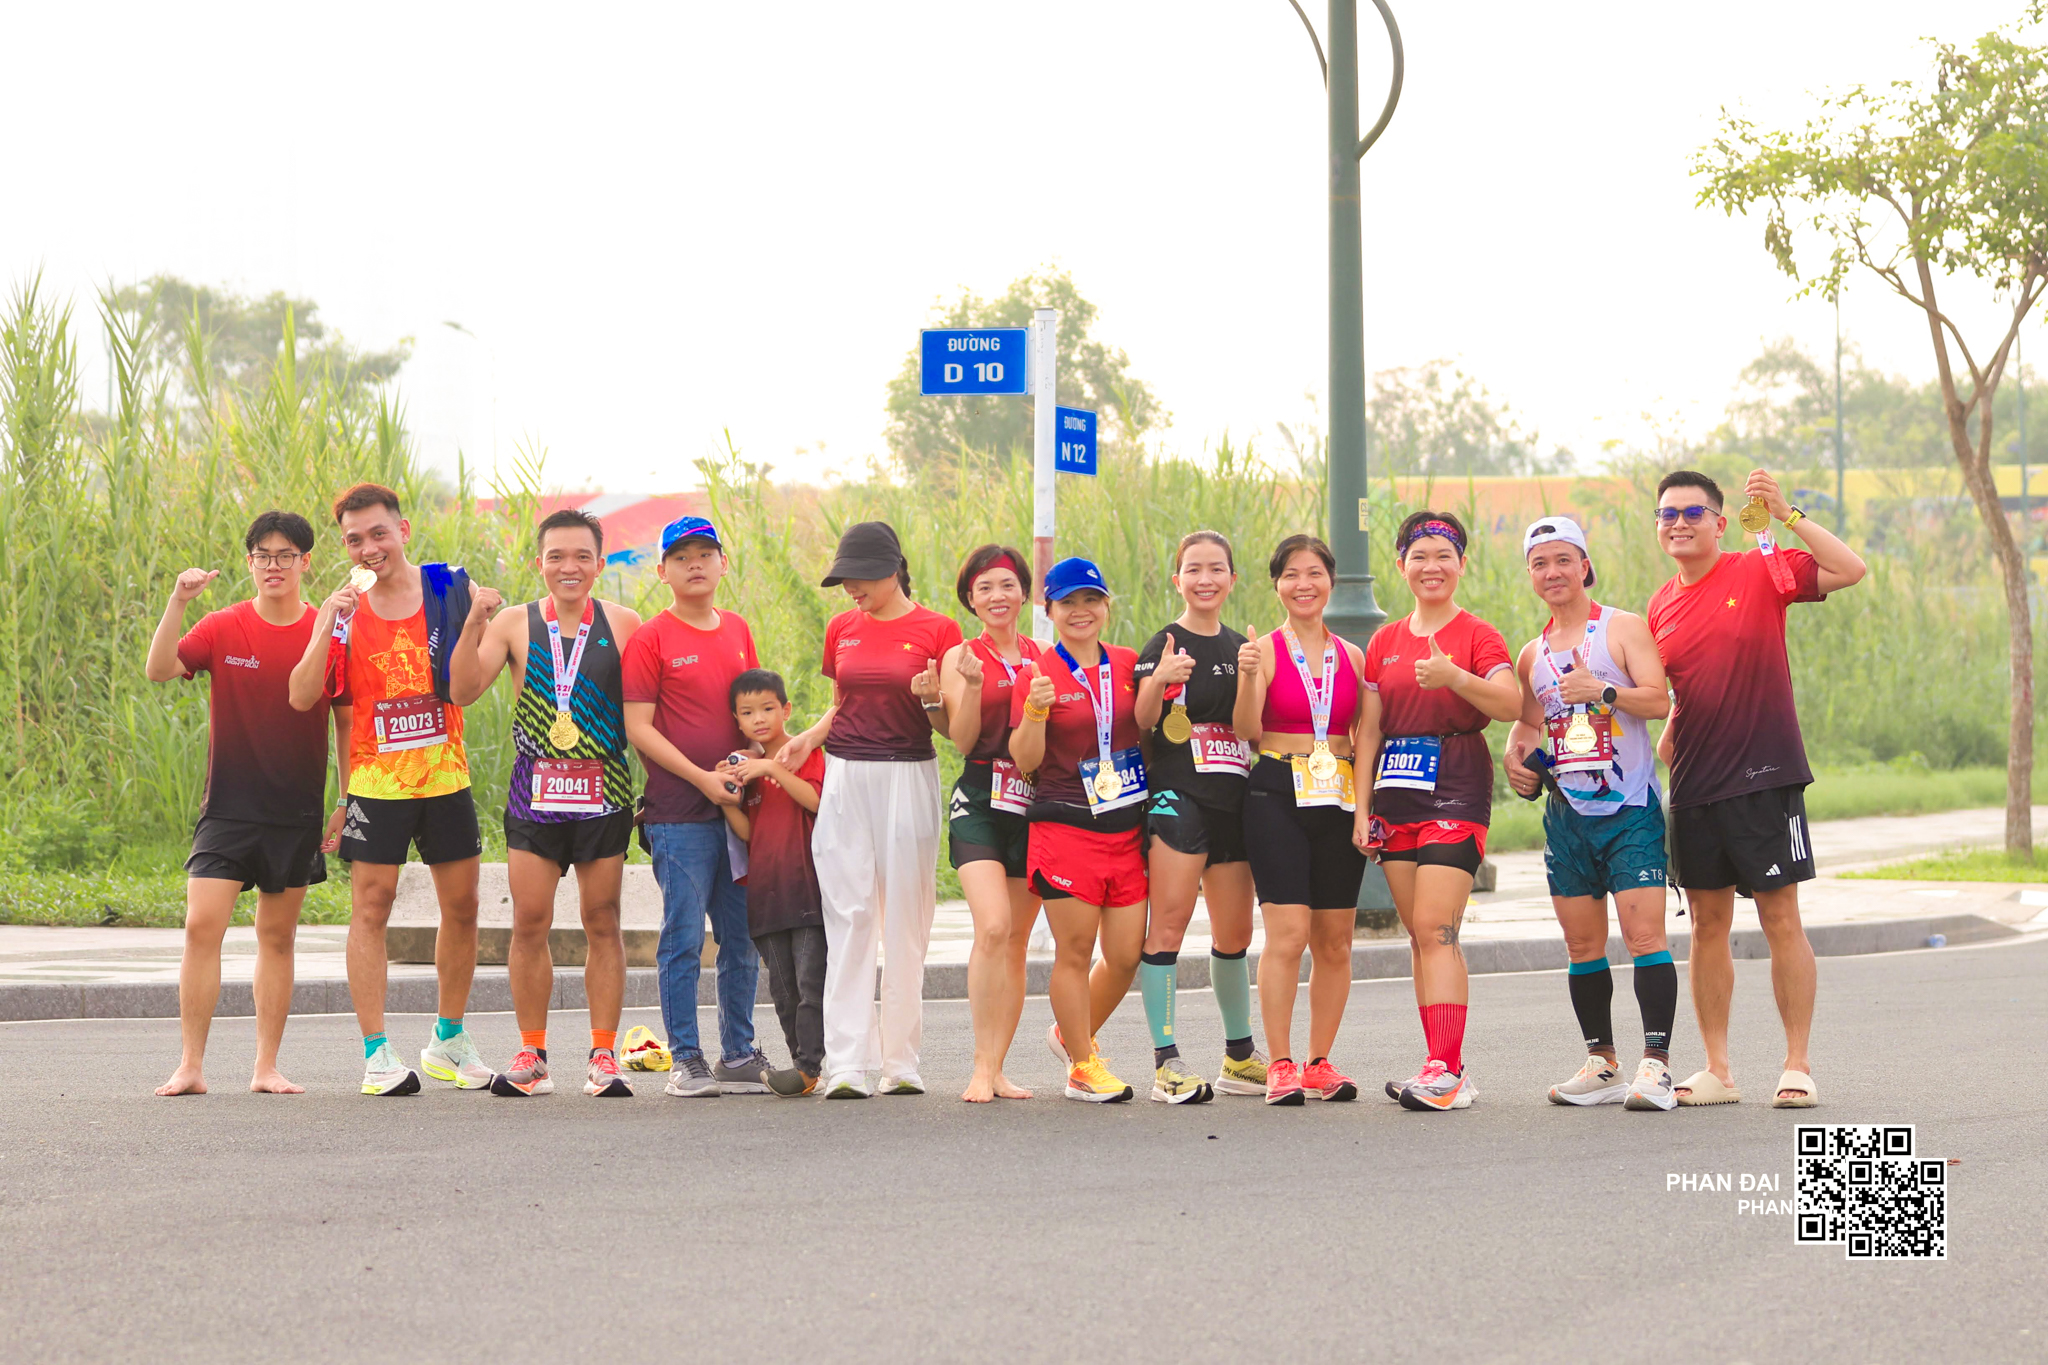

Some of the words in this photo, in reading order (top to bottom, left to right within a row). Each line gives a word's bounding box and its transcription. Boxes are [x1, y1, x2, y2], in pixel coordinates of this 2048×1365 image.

[947, 333, 1001, 352] ĐƯỜNG
[944, 363, 963, 383] D
[973, 362, 1004, 383] 10
[672, 655, 699, 668] SNR
[1135, 663, 1158, 673] RUN
[1221, 663, 1235, 675] T8
[1059, 691, 1086, 703] SNR
[389, 712, 434, 733] 20073
[1205, 740, 1244, 759] 20584
[1386, 753, 1423, 770] 51017
[546, 777, 589, 794] 20041
[1650, 868, 1664, 881] T8
